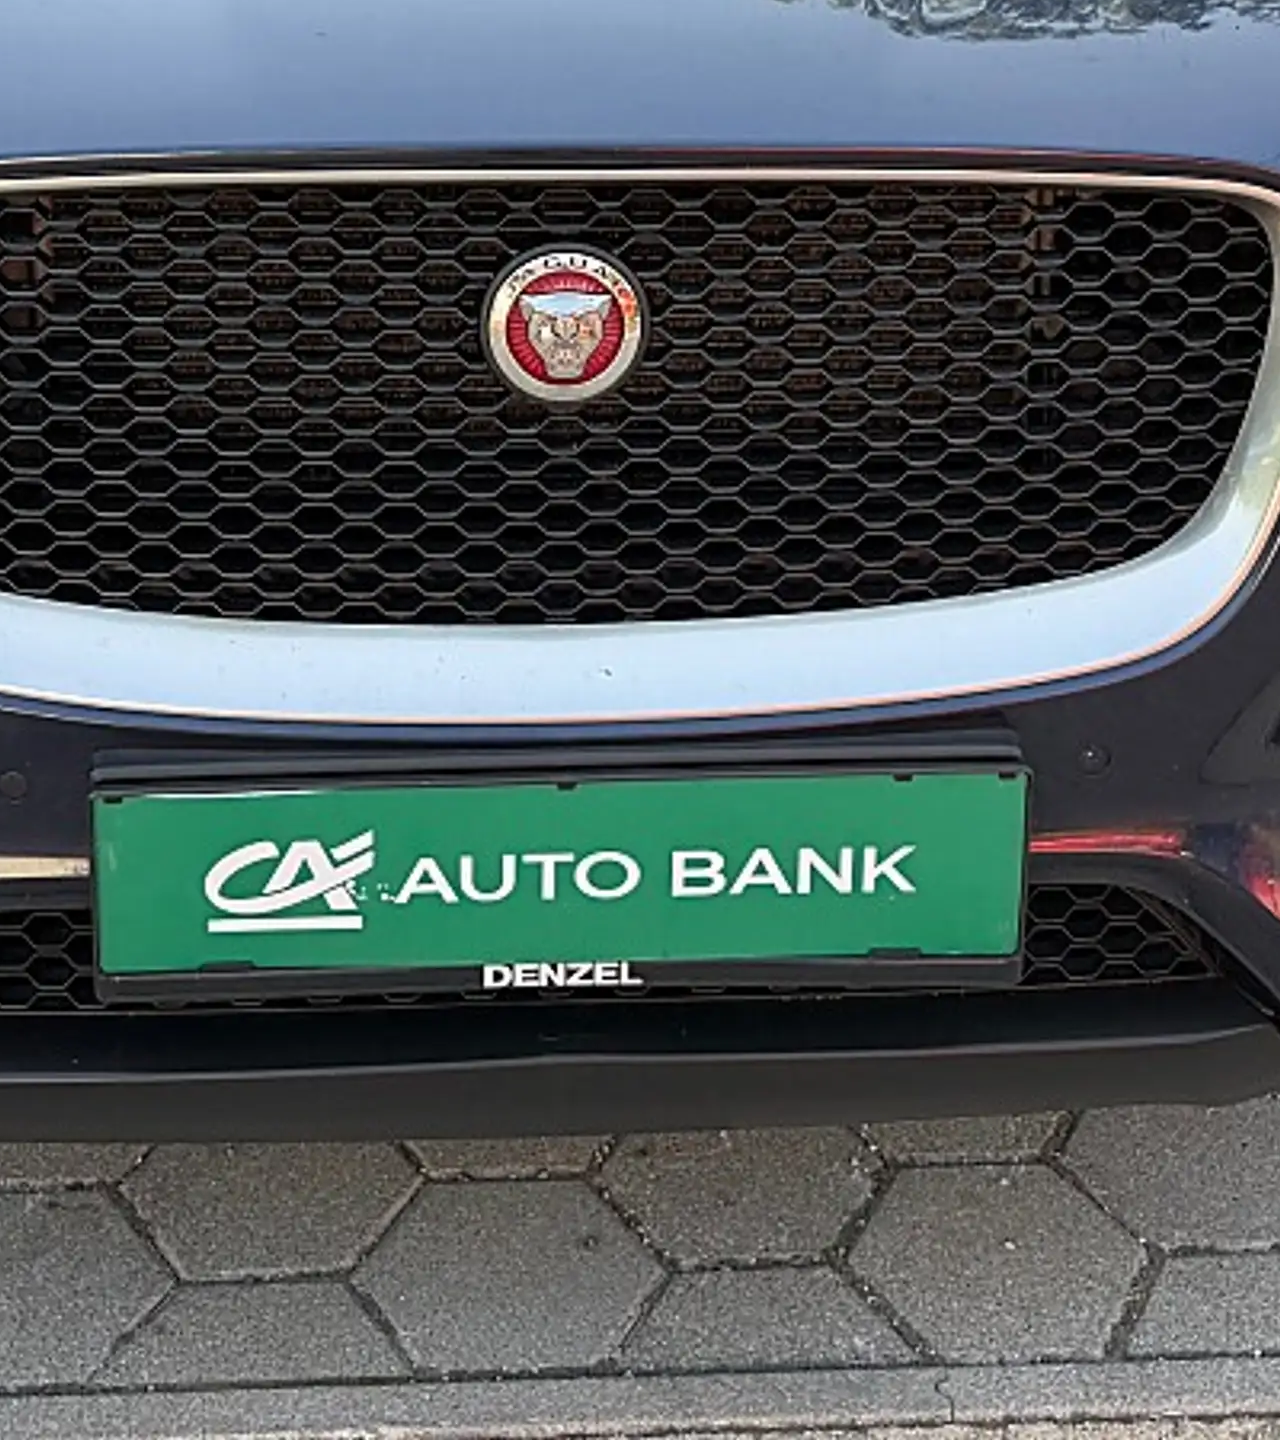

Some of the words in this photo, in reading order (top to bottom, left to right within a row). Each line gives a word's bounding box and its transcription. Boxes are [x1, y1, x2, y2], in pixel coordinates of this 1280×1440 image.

[395, 850, 642, 905] AUTO
[671, 844, 917, 898] BANK
[481, 962, 644, 989] DENZEL
